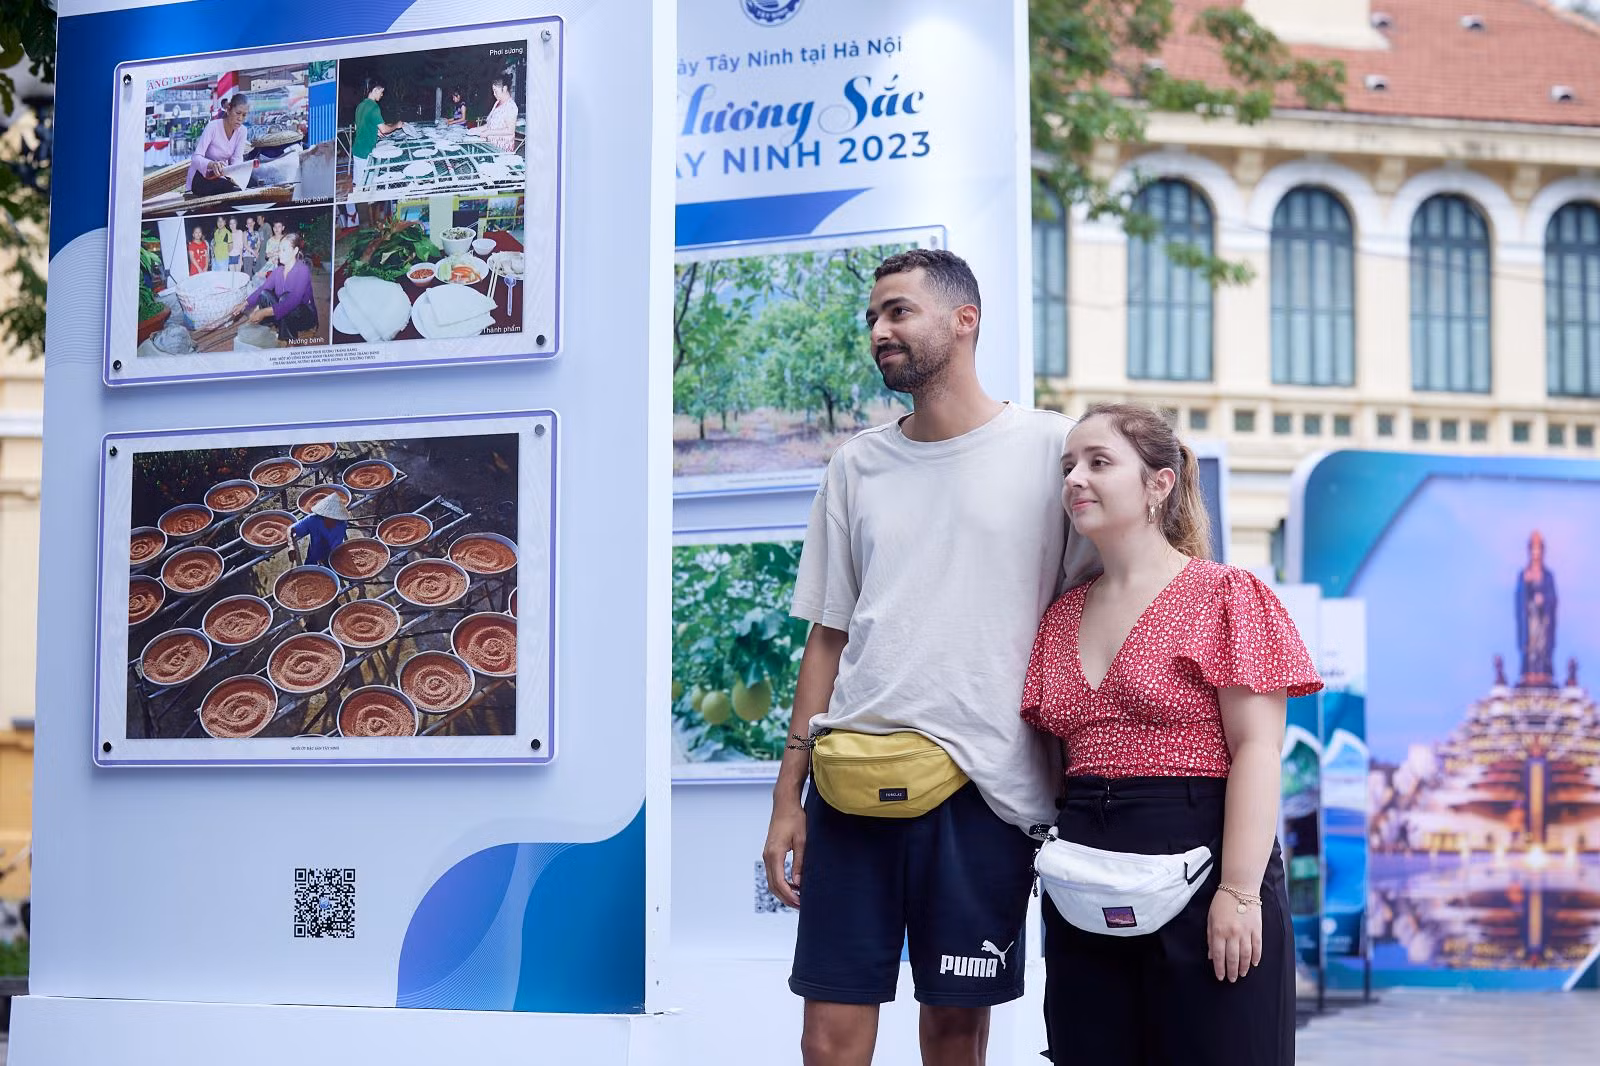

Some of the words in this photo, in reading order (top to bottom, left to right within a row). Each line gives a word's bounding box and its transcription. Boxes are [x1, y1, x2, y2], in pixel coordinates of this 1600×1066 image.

[677, 58, 699, 77] ày
[706, 53, 740, 73] Tây
[748, 47, 793, 68] Ninh
[800, 43, 826, 65] tại
[833, 40, 860, 59] Hà
[867, 36, 902, 58] Nội
[817, 73, 925, 135] Sắc
[676, 150, 706, 178] Y
[723, 140, 821, 175] NINH
[838, 130, 931, 164] 2023
[940, 955, 998, 977] PUMA
